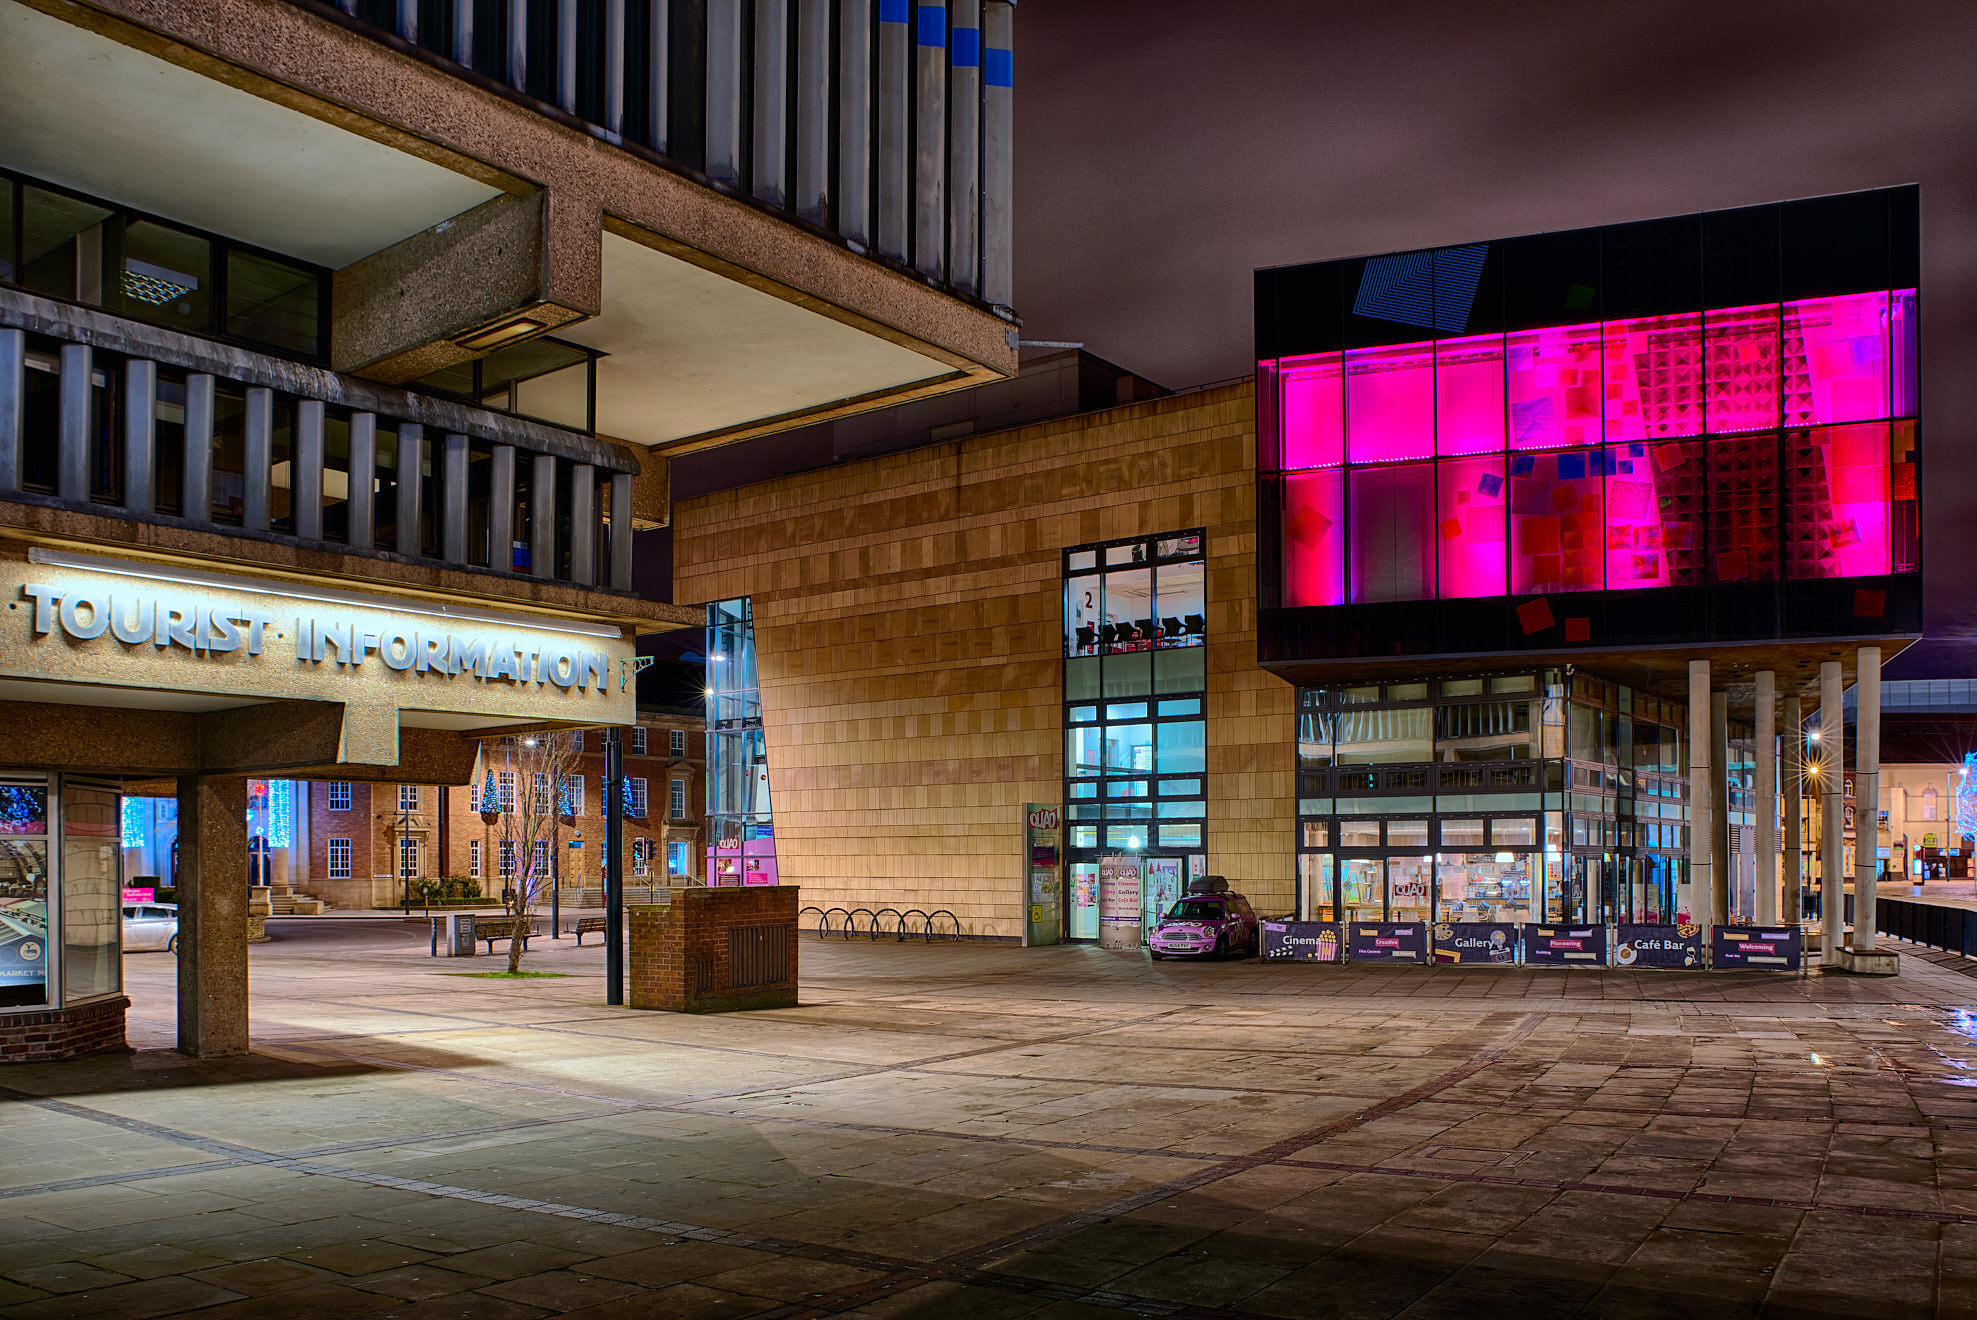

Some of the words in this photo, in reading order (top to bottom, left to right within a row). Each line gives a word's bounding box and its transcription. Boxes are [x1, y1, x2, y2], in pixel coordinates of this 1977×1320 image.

[1085, 591, 1093, 609] 2
[23, 583, 271, 656] TOURIST
[296, 616, 610, 692] INFORMATION
[1030, 810, 1056, 830] QUAD
[719, 838, 738, 849] QUAD
[1119, 868, 1137, 876] QUAD
[1396, 884, 1425, 896] QUAD
[1282, 935, 1322, 945] Cinema
[1455, 937, 1495, 950] Gallery
[1550, 940, 1581, 948] Pioneering
[1634, 939, 1661, 950] Café
[1663, 939, 1685, 950] Bar
[1738, 943, 1774, 952] Welcoming
